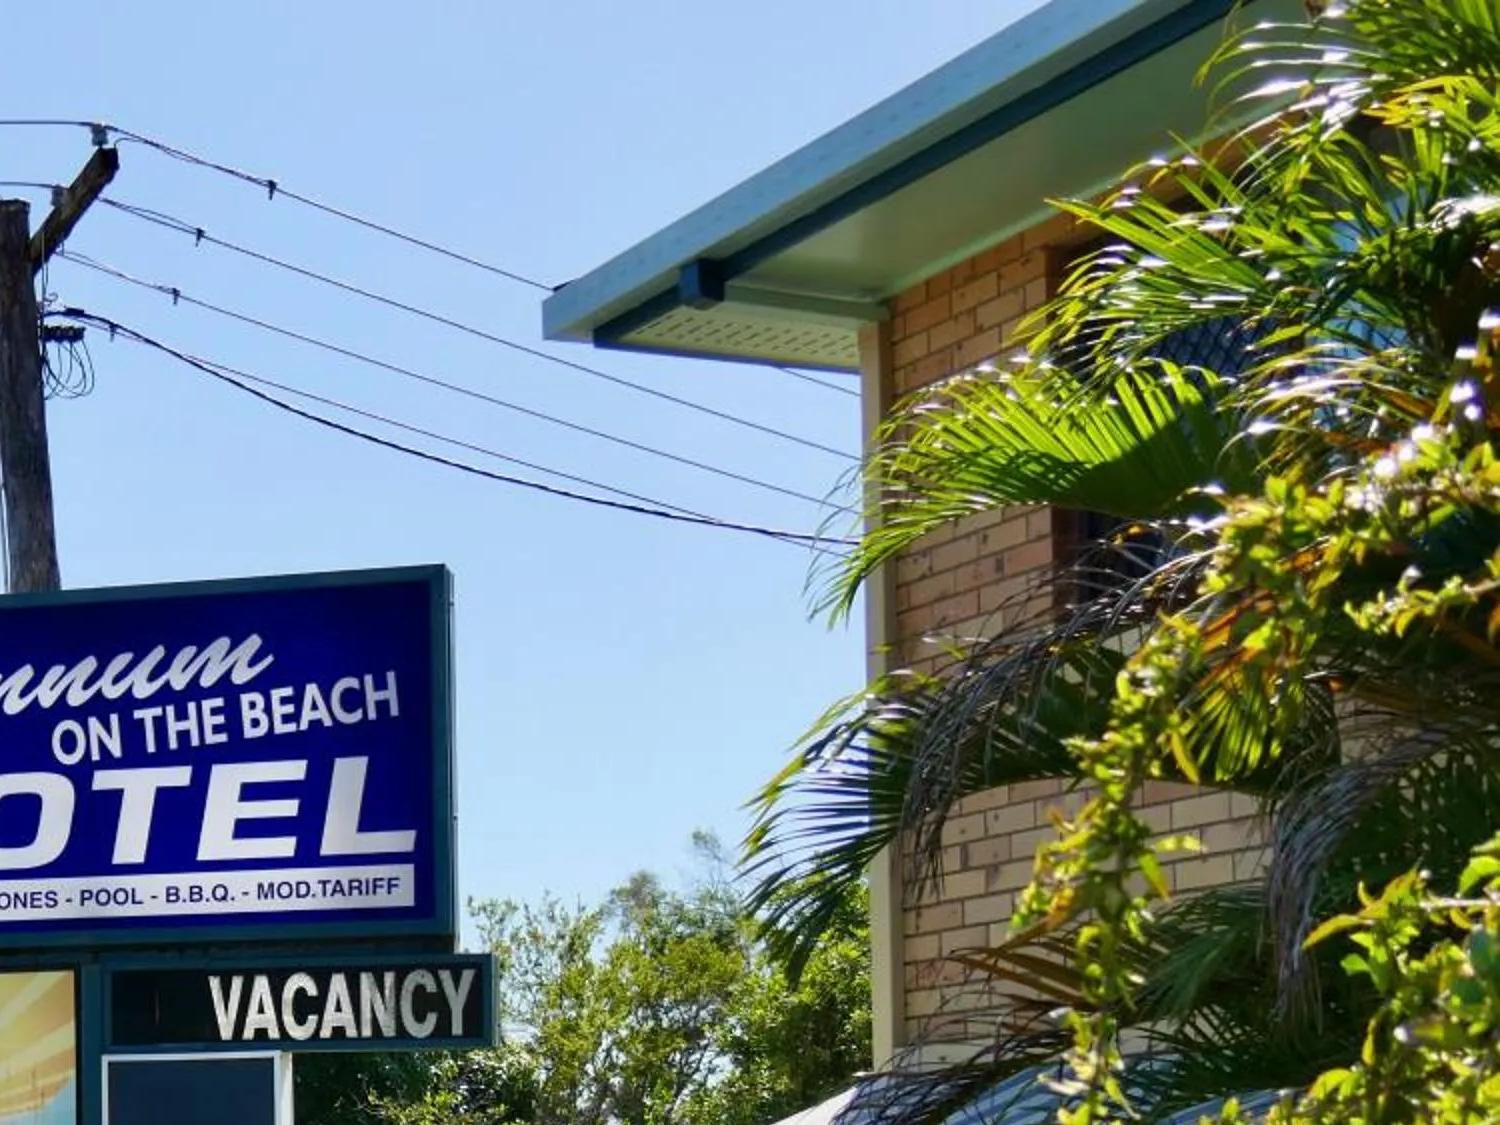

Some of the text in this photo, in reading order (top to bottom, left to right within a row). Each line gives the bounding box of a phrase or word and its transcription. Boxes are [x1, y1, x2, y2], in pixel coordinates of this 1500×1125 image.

[51, 671, 399, 765] ON THE BEACH
[79, 887, 145, 908] POOL
[165, 883, 236, 904] B.B.Q.
[208, 969, 475, 1041] VACANCY
